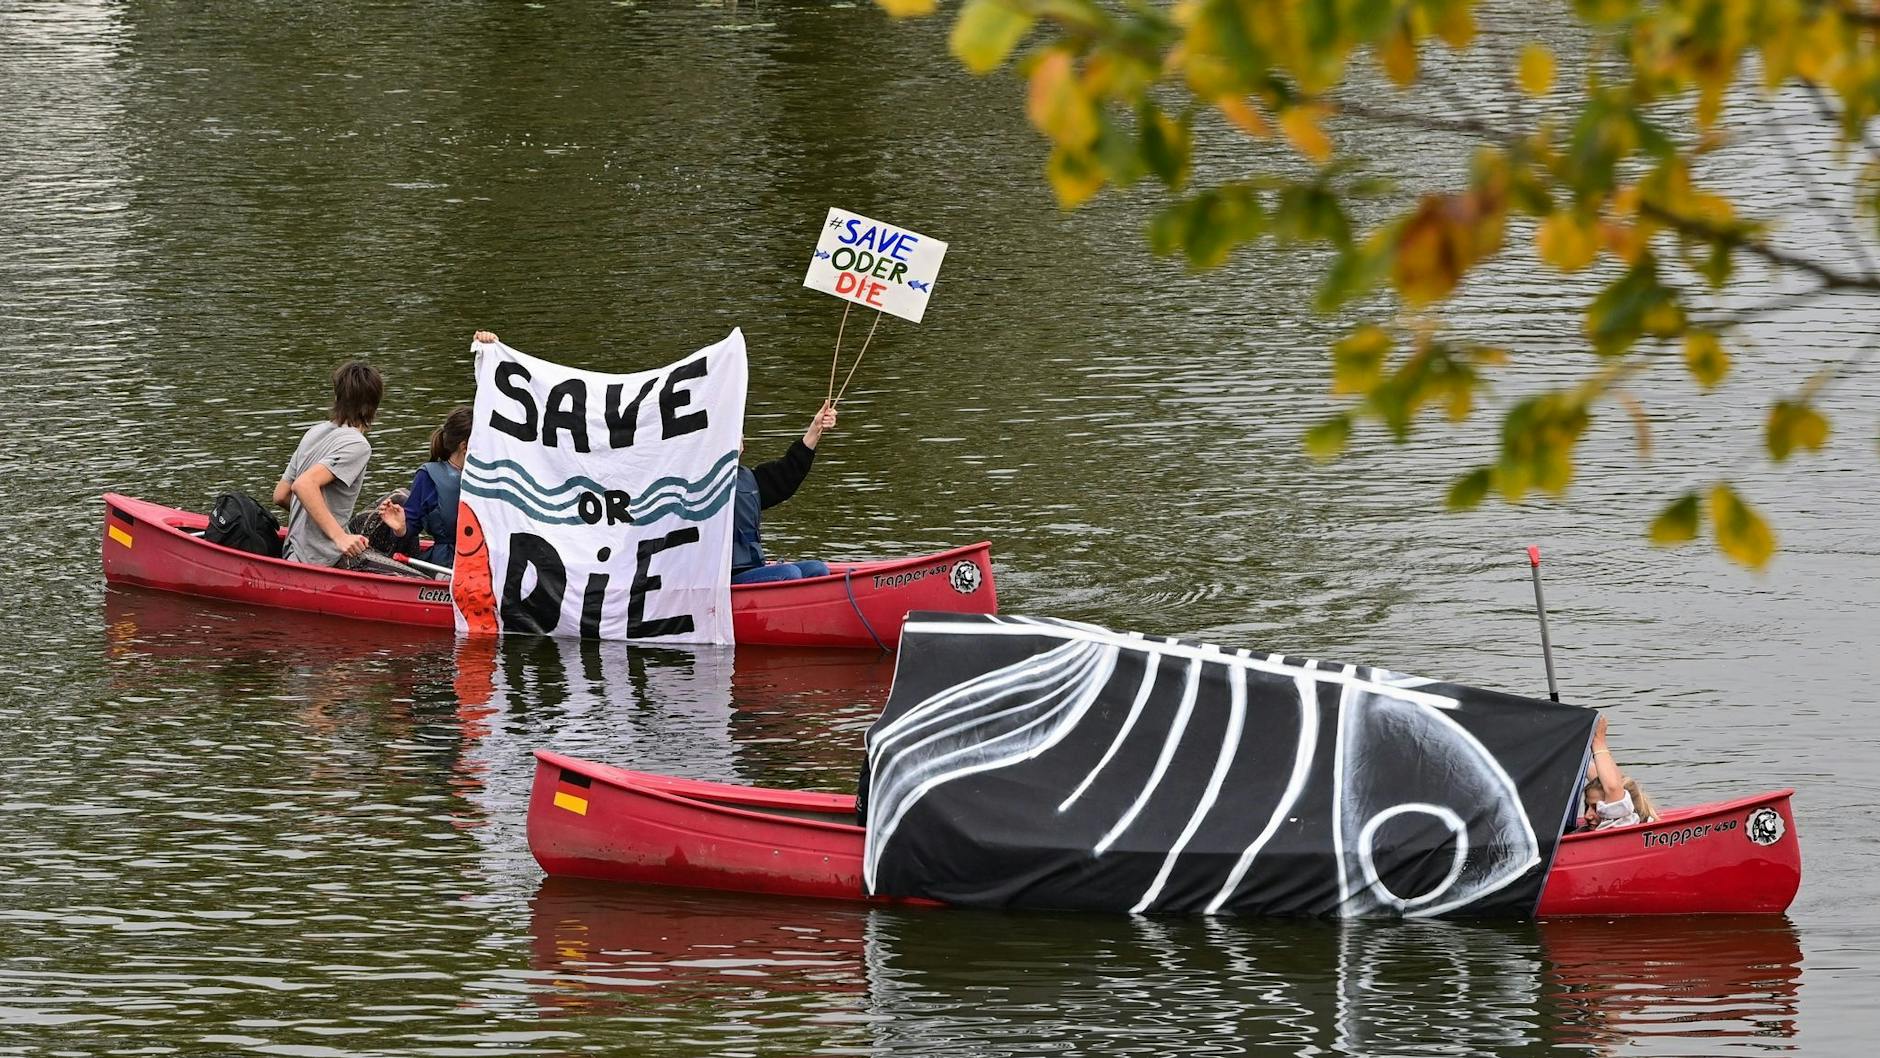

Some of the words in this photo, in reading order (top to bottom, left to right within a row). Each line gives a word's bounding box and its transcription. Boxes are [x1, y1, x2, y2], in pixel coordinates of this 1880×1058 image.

[829, 216, 919, 261] #SAVE
[831, 247, 908, 284] ODER
[489, 357, 708, 453] SAVE
[578, 489, 635, 526] OR
[873, 568, 928, 589] Trapper
[929, 565, 948, 576] 450
[1642, 824, 1712, 848] Trapper
[1713, 819, 1738, 833] 450
